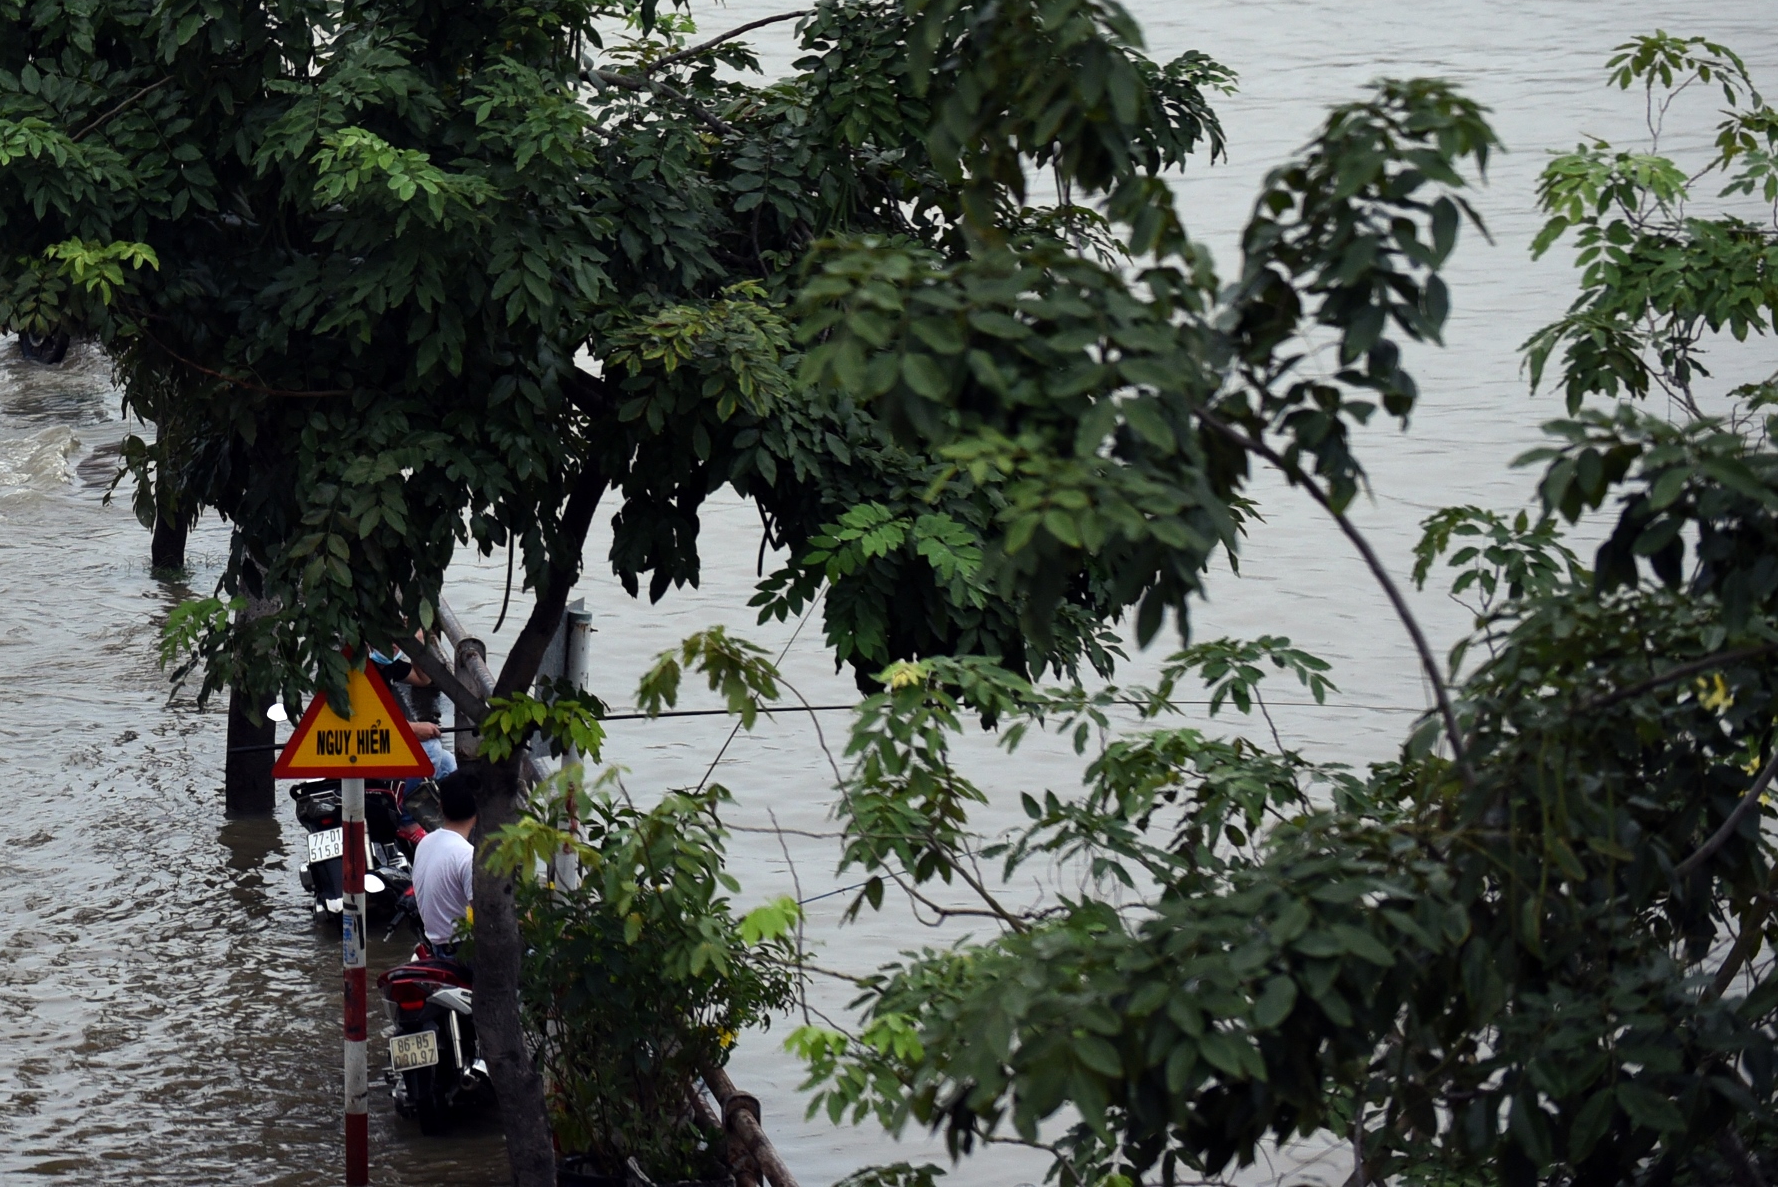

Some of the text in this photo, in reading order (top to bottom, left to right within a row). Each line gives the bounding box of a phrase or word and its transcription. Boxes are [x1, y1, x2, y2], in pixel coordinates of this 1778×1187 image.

[316, 719, 390, 756] NGUY HIỂM
[313, 829, 341, 847] 77-D1
[311, 842, 340, 861] 515.8
[397, 1034, 429, 1053] 86-B5
